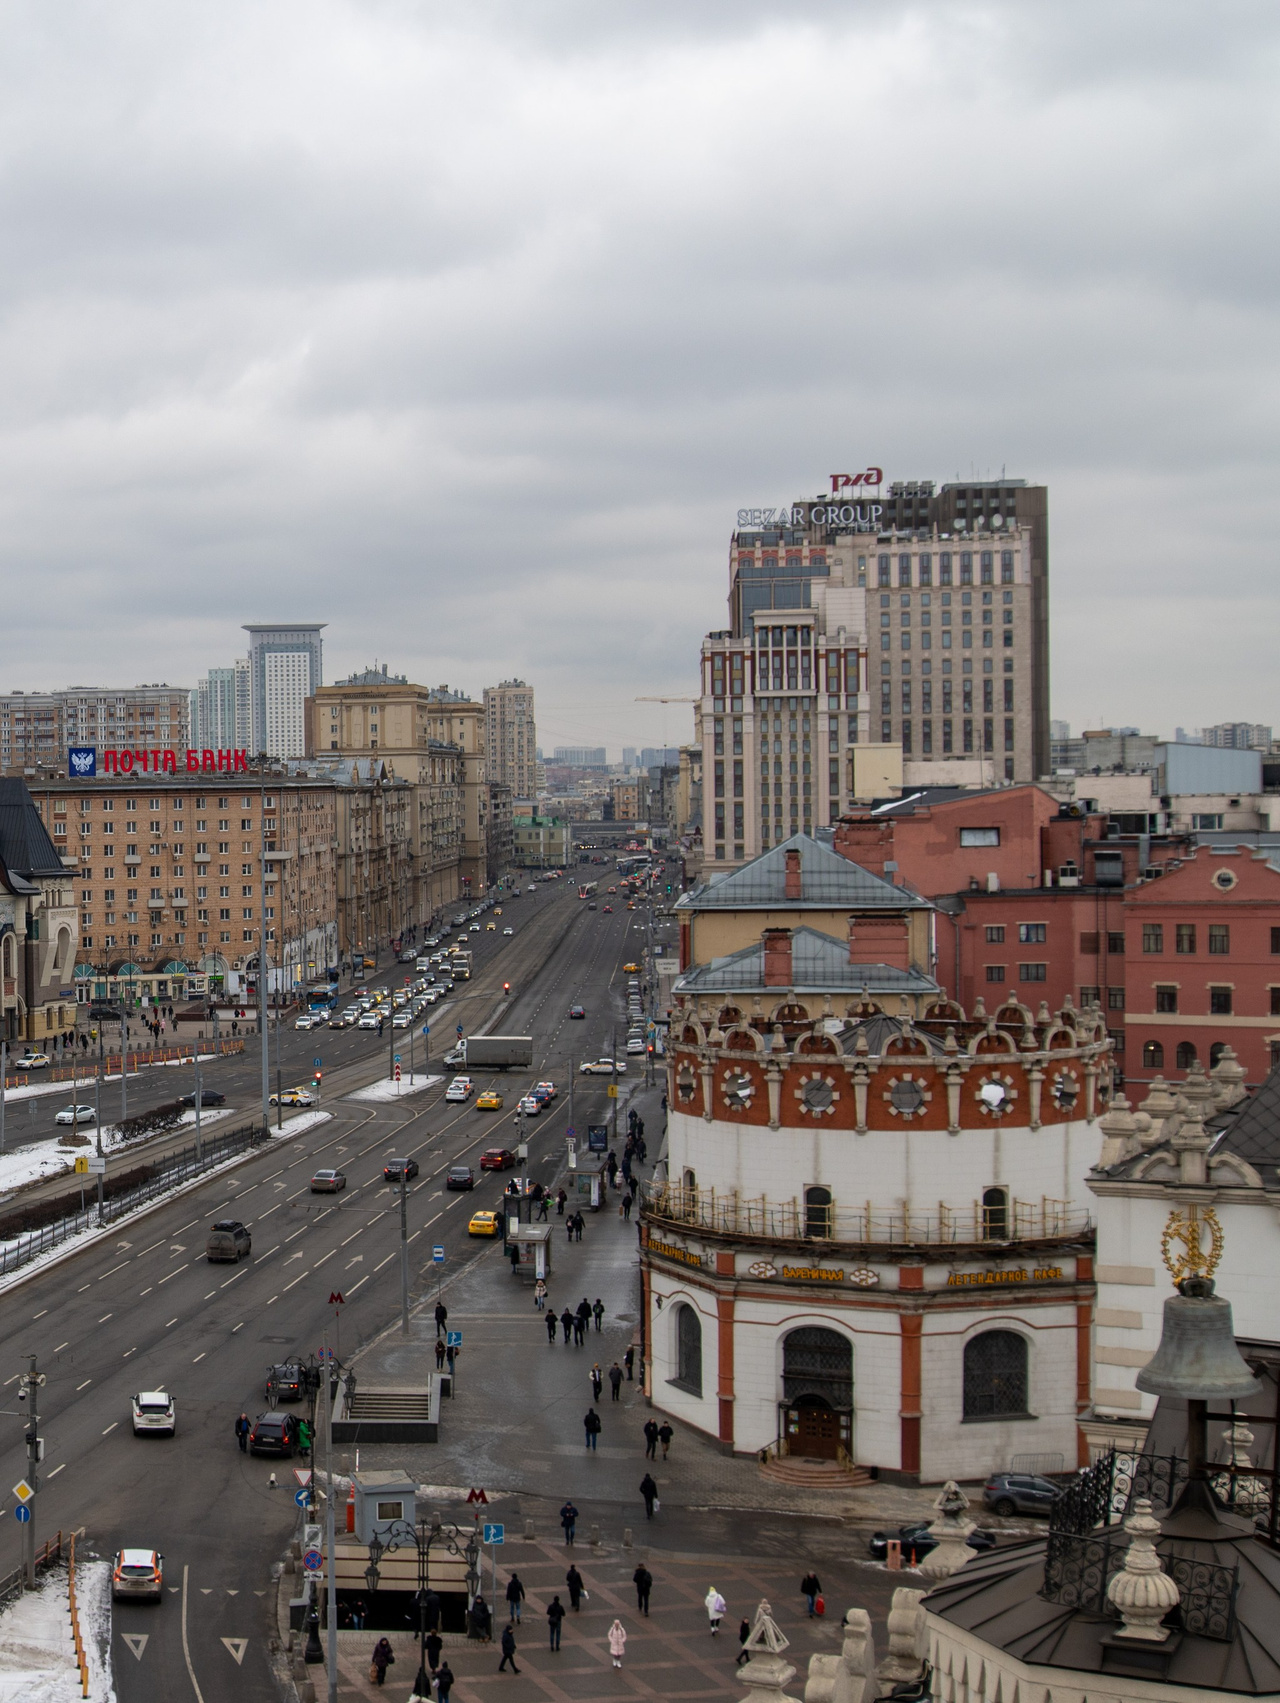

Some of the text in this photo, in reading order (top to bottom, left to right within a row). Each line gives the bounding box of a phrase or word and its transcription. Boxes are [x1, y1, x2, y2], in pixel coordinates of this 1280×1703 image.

[737, 505, 883, 527] SEZAR GROUP
[104, 748, 248, 773] ПОЧТА БАНК
[948, 1267, 1063, 1286] ЛЕГЕНДАРНОЕ КАФЕ
